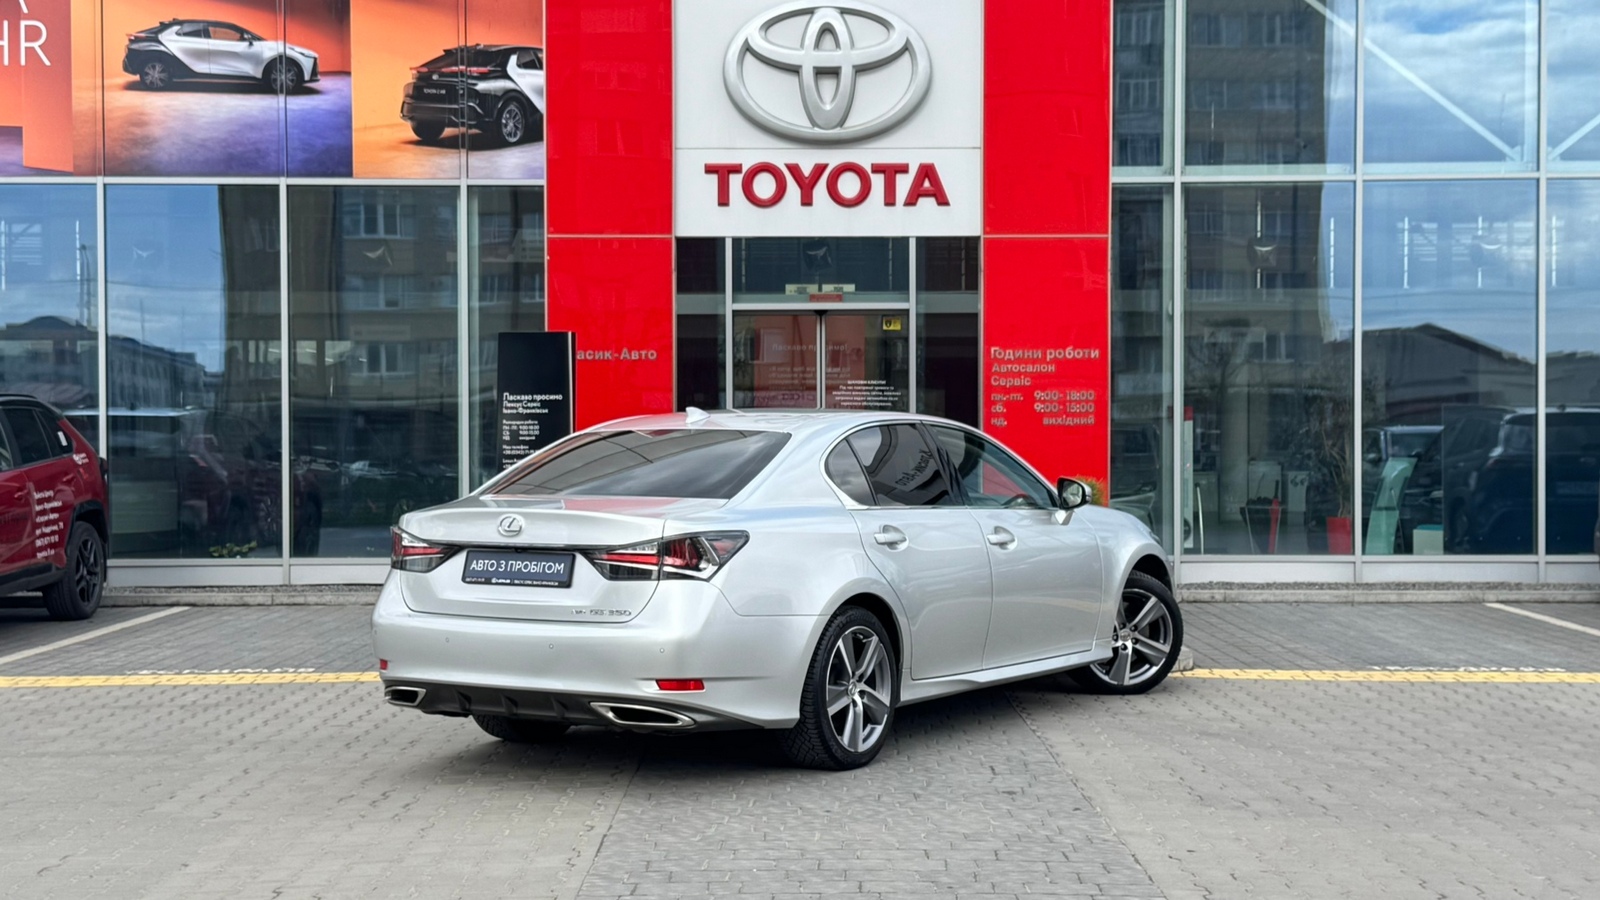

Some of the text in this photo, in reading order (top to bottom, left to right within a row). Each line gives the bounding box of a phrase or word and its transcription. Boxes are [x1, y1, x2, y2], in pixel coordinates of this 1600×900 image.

[704, 161, 951, 208] TOYOTA
[576, 346, 657, 361] асик-Авто
[990, 346, 1100, 361] Години роботи
[991, 363, 1056, 373] Автосалон
[990, 375, 1032, 388] Сервіс
[990, 403, 1007, 413] сб.
[1042, 414, 1095, 426] вихідний
[469, 559, 497, 571] АВТО
[507, 560, 565, 574] ПРОБІГОМ
